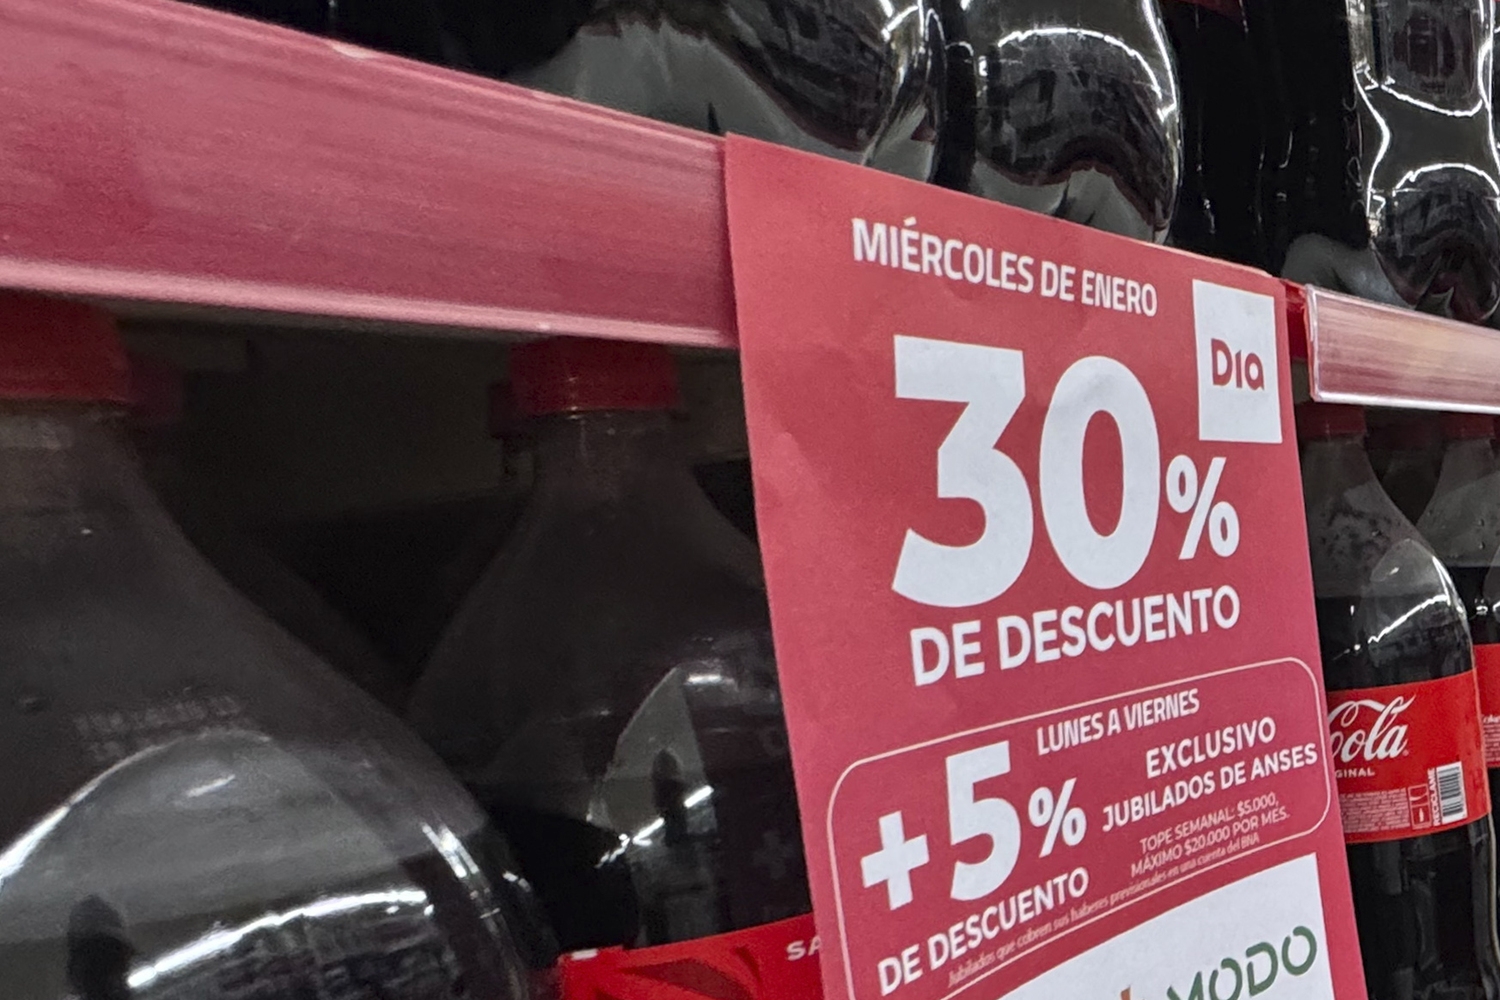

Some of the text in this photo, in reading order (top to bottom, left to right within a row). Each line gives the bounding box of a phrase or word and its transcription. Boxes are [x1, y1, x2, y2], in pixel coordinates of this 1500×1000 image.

[852, 217, 1157, 317] MIÉRCOLES DE ENERO
[891, 335, 1240, 607] 30%
[910, 585, 1240, 687] DE DESCUENTO
[1037, 688, 1200, 756] LUNES A VIERNES
[1146, 717, 1276, 779] EXCLUSIVO
[1103, 742, 1318, 832] JUBILADOS DE ANSES
[1131, 844, 1182, 878] MÁXIMO
[1184, 826, 1231, 857] $20.000
[1232, 813, 1259, 838] POR
[1140, 827, 1173, 854] TOPE
[877, 867, 1090, 997] DE DESCUENTO
